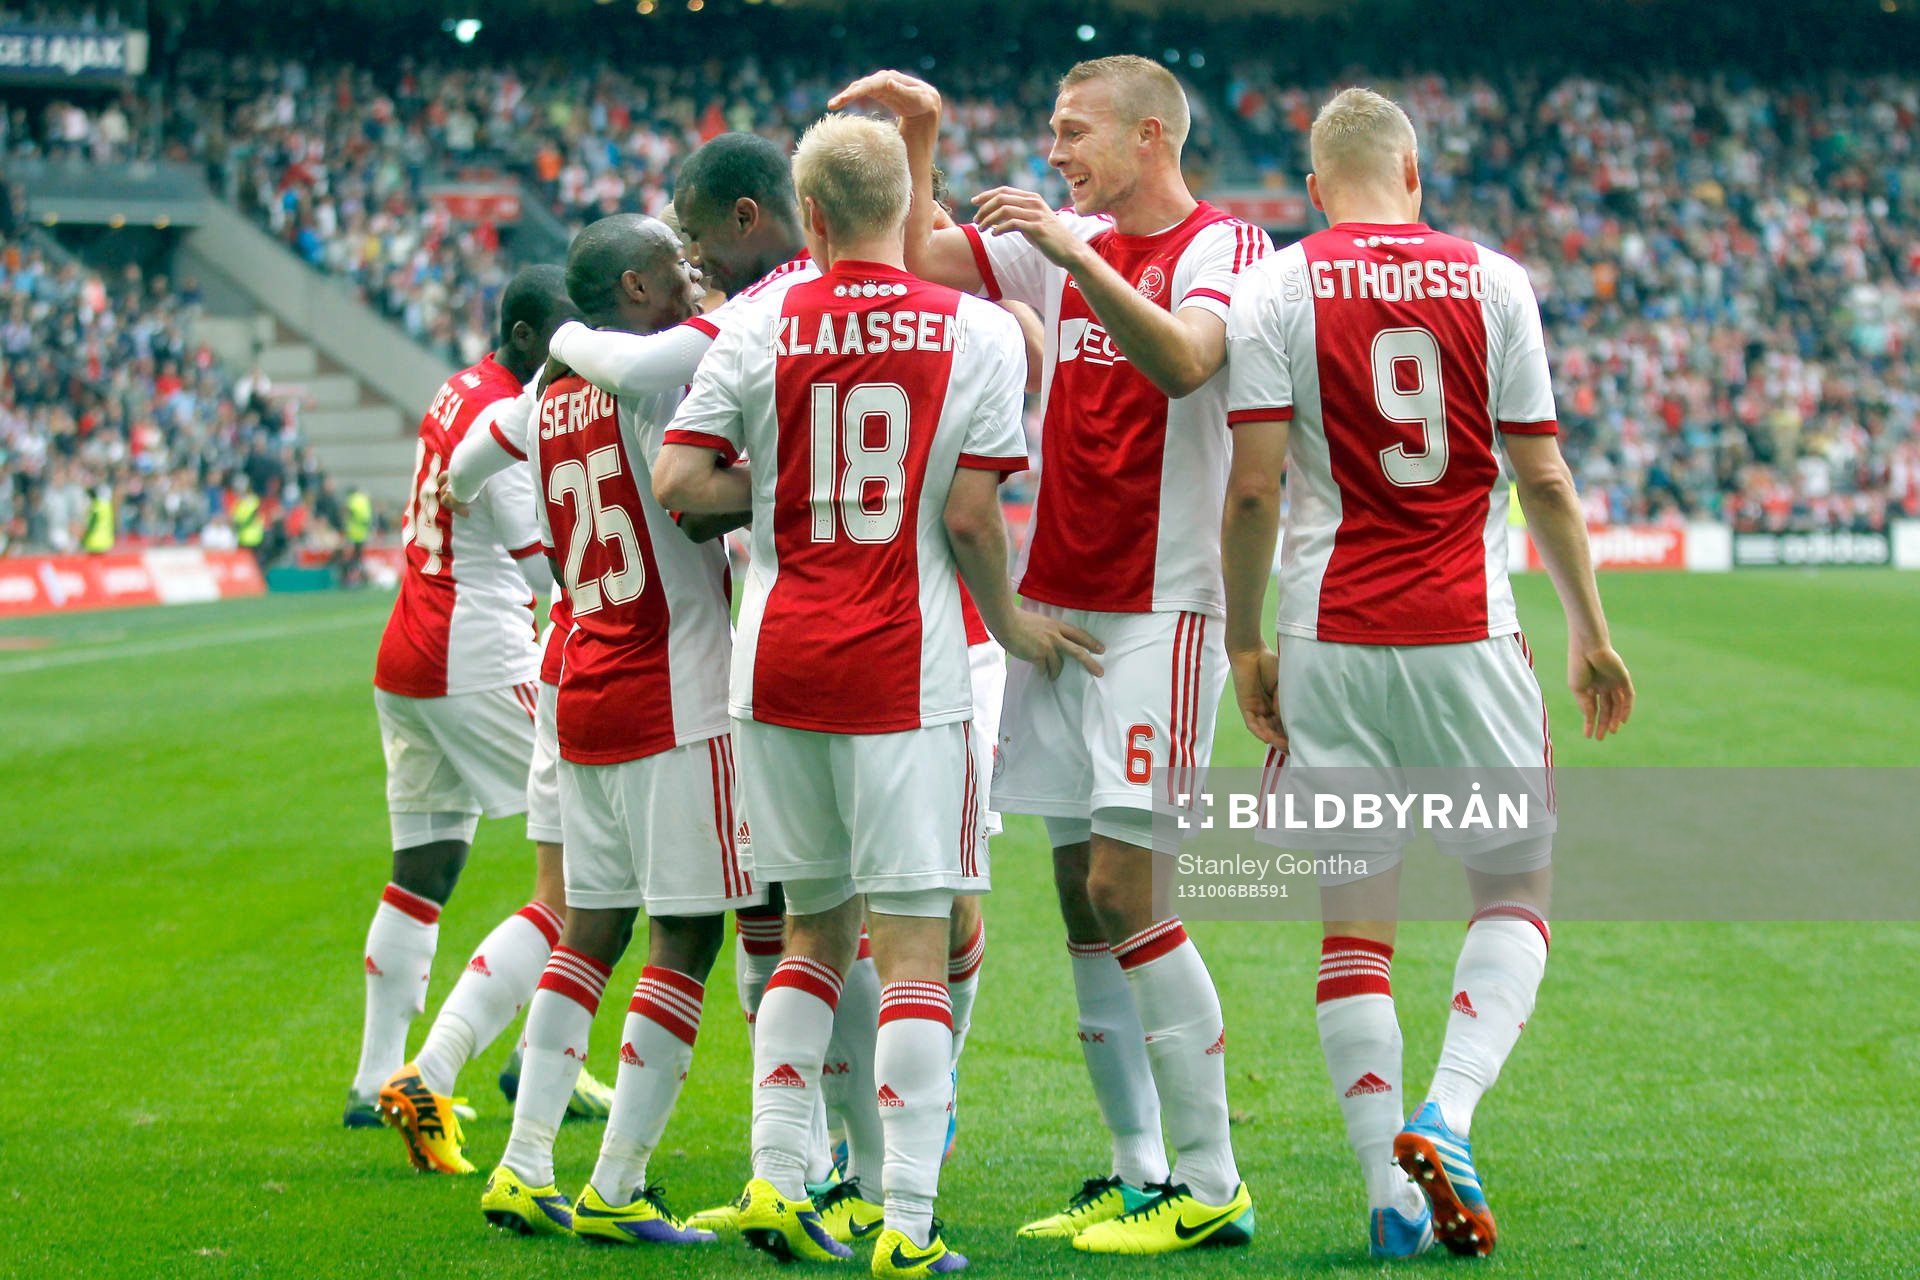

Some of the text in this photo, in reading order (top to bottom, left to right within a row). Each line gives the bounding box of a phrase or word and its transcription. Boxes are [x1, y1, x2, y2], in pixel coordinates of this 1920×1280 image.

[768, 310, 969, 357] KLAASSEN
[1371, 326, 1449, 488] 9
[810, 382, 911, 544] 18
[548, 443, 645, 617] 25
[1125, 723, 1155, 785] 6
[390, 1075, 446, 1140] NIKE
[759, 1077, 806, 1088] adidas
[1344, 1084, 1392, 1098] adidas
